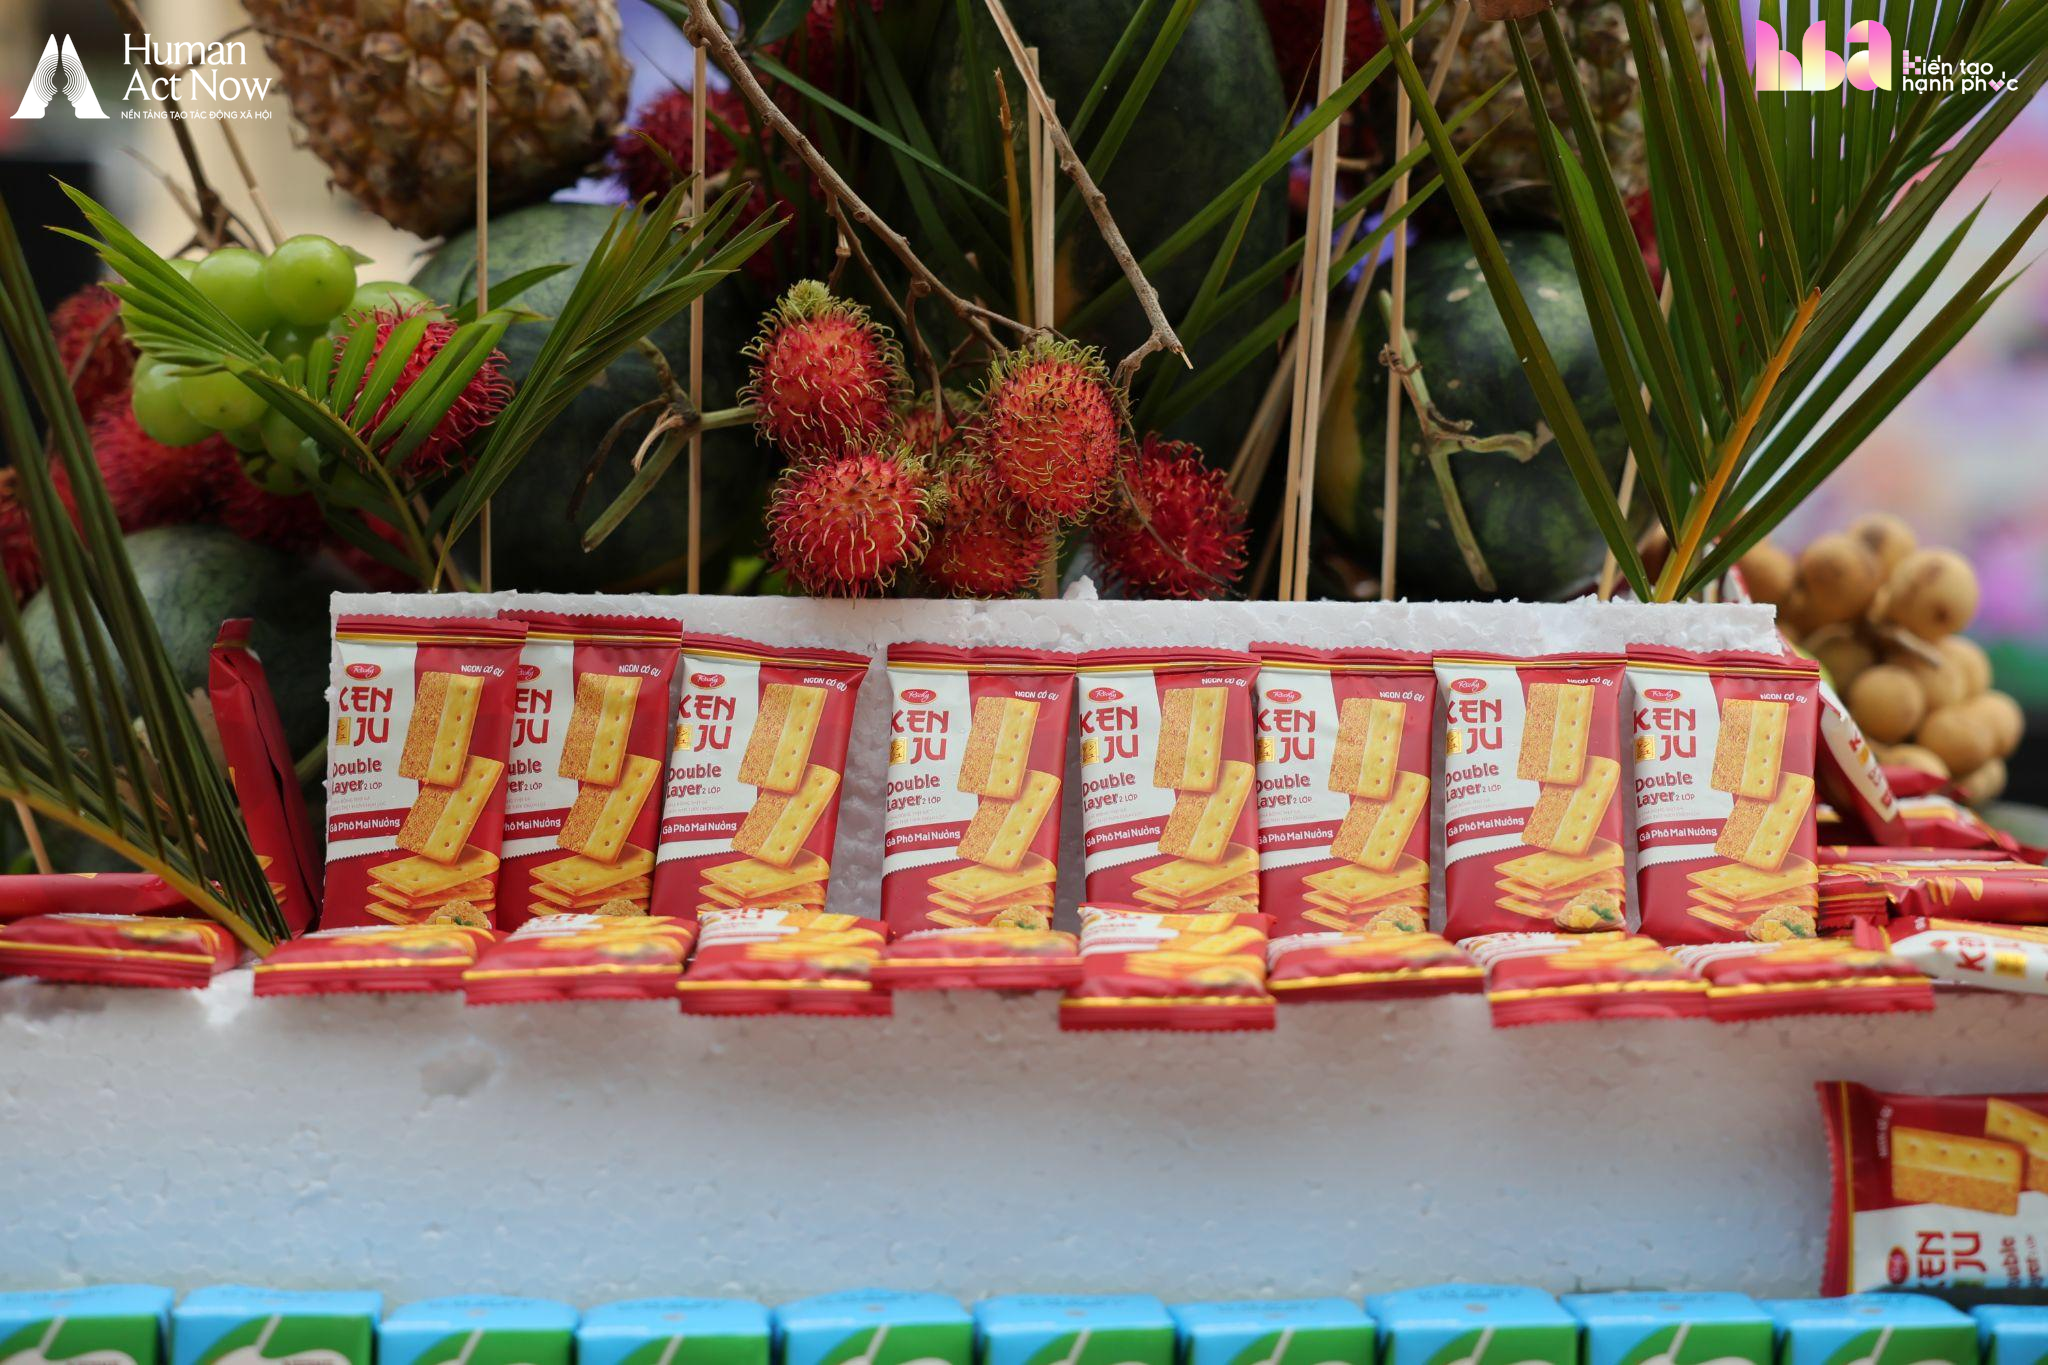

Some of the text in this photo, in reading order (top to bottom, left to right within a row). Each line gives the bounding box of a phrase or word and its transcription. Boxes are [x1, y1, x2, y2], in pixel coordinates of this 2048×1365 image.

[618, 664, 640, 673] NGON
[650, 668, 661, 677] GU
[514, 688, 552, 714] EN
[1413, 693, 1425, 702] GU
[354, 717, 390, 747] JU
[890, 709, 949, 736] KEN
[1080, 706, 1138, 737] KEN
[1633, 707, 1696, 735] KEN
[512, 718, 549, 748] JU
[693, 725, 732, 752] JU
[1466, 726, 1503, 755] JU
[910, 737, 947, 765] JU
[1103, 734, 1138, 763] JU
[1279, 737, 1315, 764] JU
[1660, 735, 1697, 761] JU
[508, 759, 542, 776] uble
[669, 763, 722, 782] Double
[1445, 763, 1500, 788] Double
[887, 774, 941, 797] Double
[1082, 772, 1136, 797] Double
[1256, 773, 1311, 794] Double
[1446, 783, 1481, 803] Layer
[1635, 771, 1693, 793] Double
[886, 795, 922, 813] Layer
[1083, 793, 1118, 813] Layer
[1636, 791, 1675, 808] Layer
[355, 820, 371, 830] Mai
[505, 821, 515, 831] hô
[516, 820, 532, 830] Mai
[691, 822, 707, 832] Mai
[1114, 830, 1131, 840] Mai
[1286, 831, 1303, 841] Mai
[1477, 820, 1494, 830] Mai
[1670, 828, 1686, 837] Mai
[914, 832, 930, 842] Mai
[1917, 1231, 1946, 1288] EN
[1951, 1231, 1987, 1272] JU
